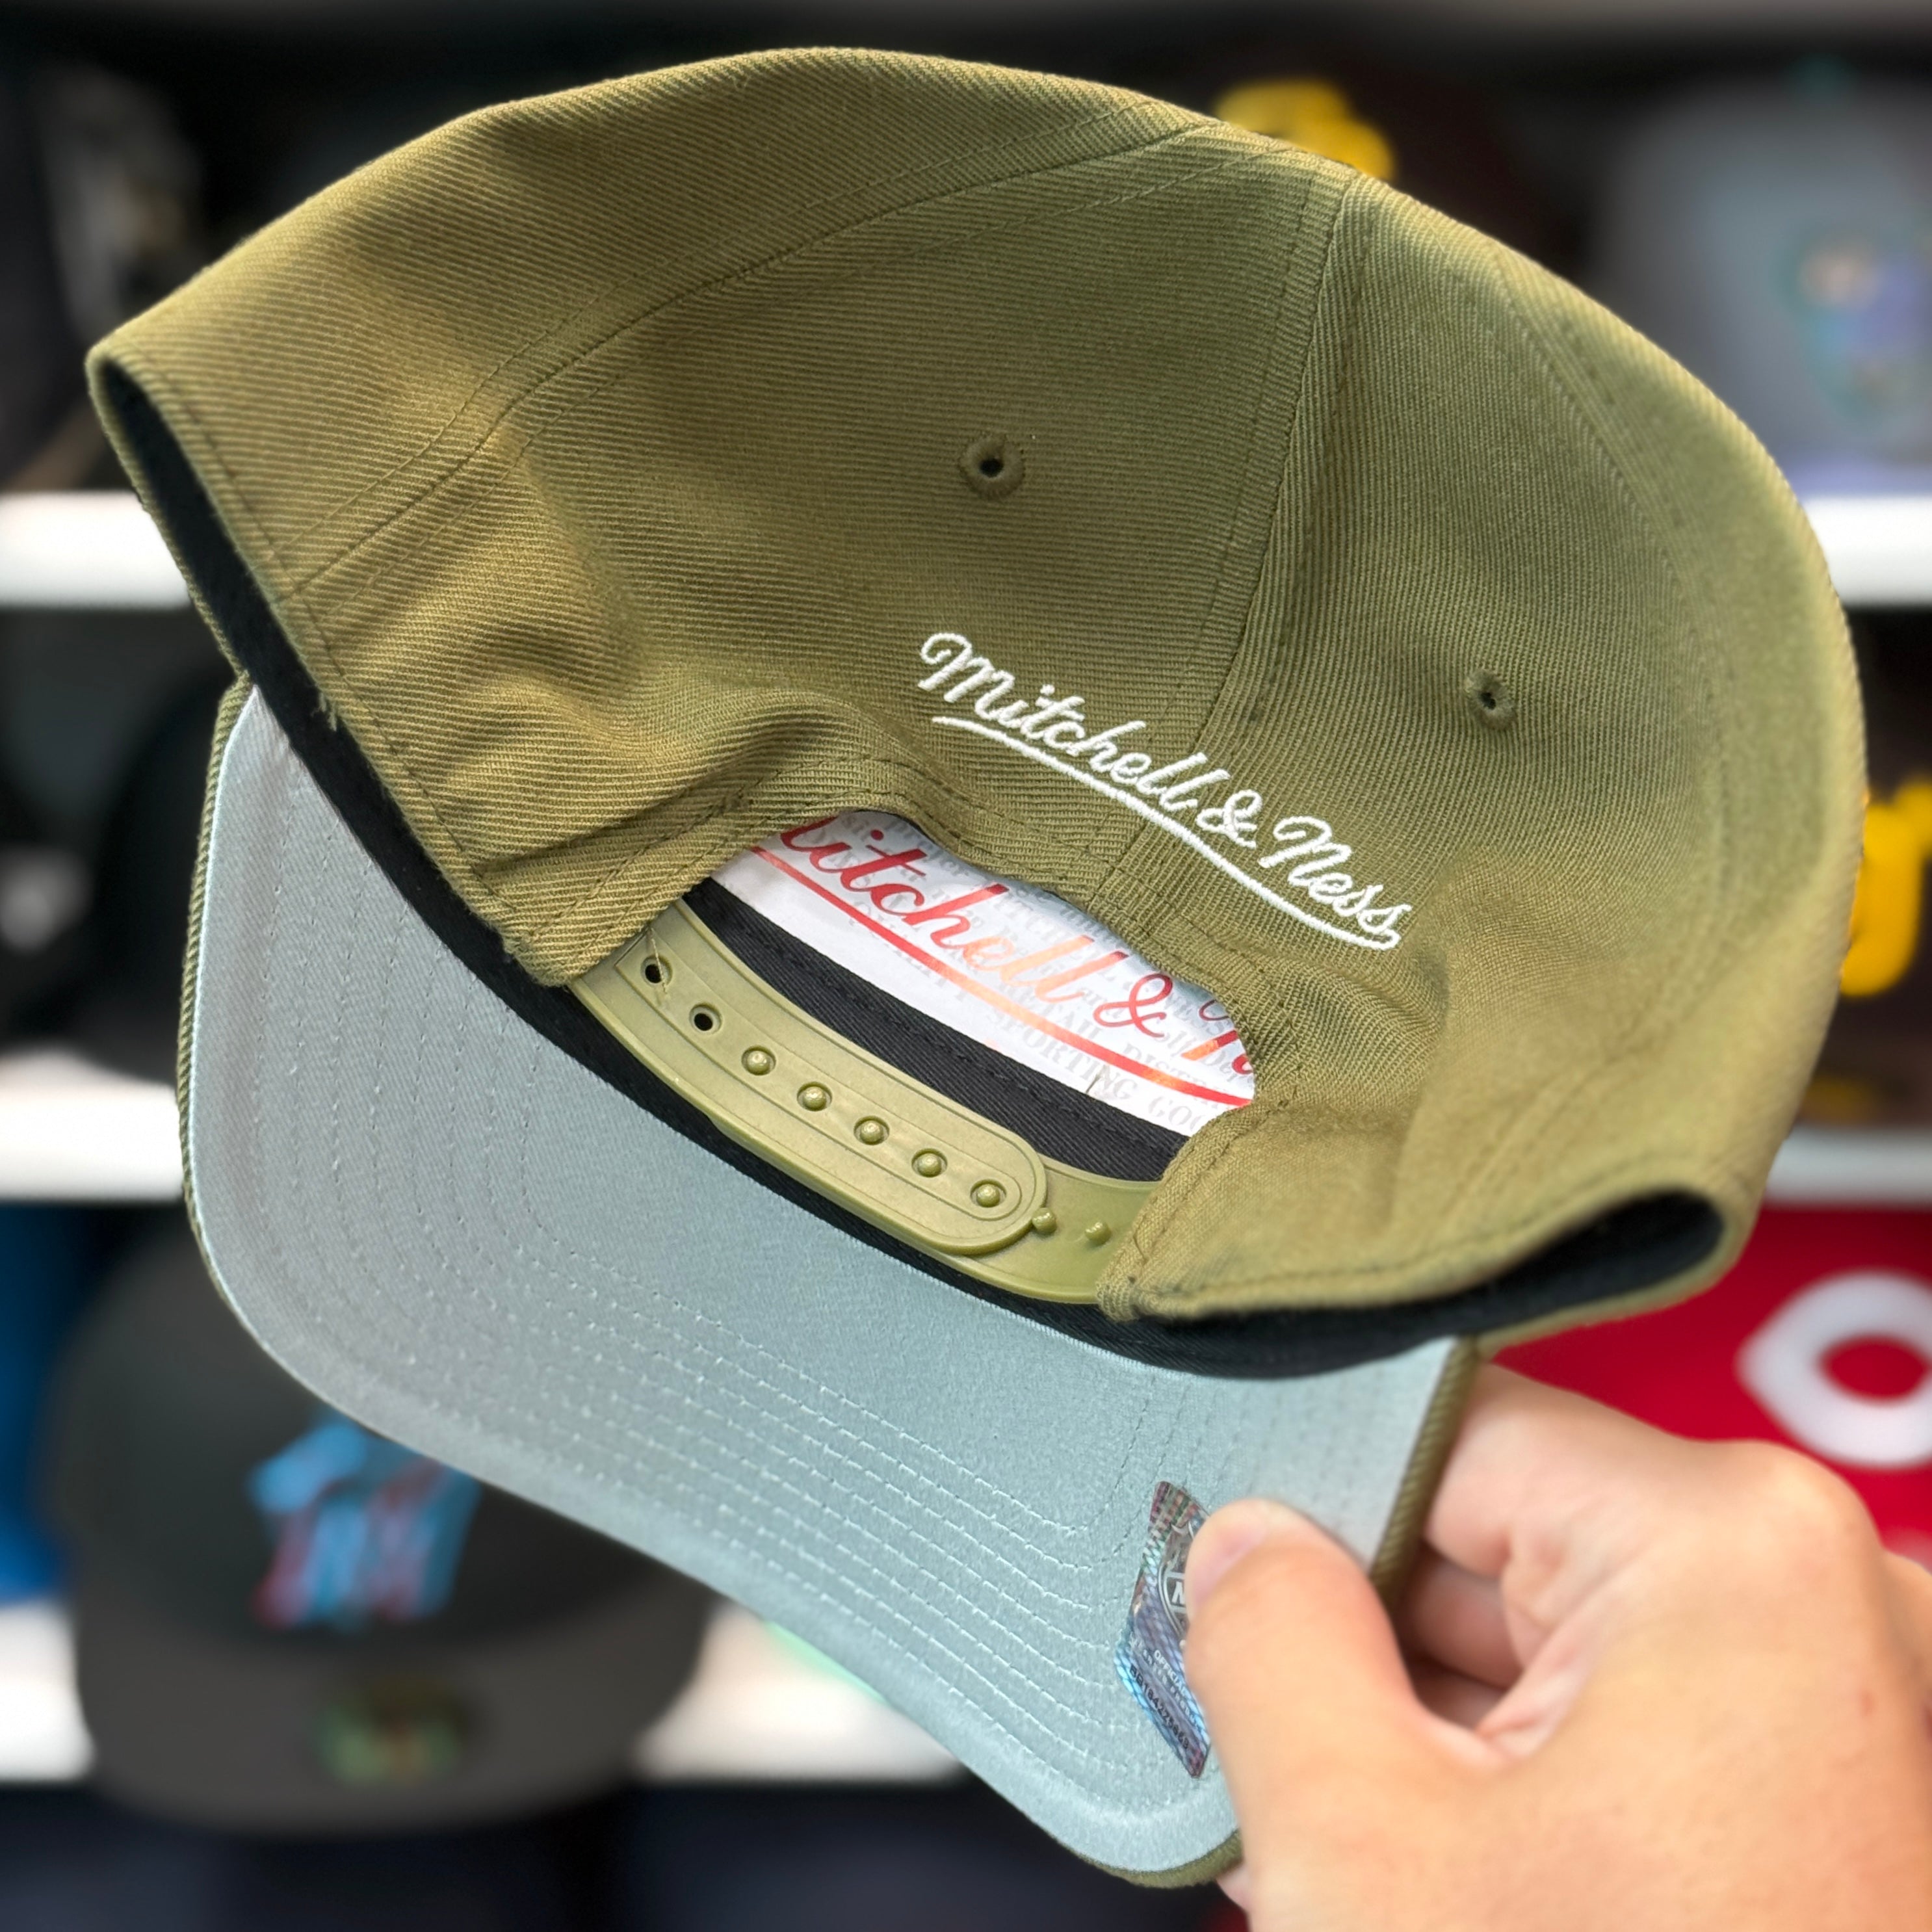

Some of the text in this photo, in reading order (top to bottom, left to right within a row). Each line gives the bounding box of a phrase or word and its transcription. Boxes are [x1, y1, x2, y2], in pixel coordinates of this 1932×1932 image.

[919, 633, 1413, 935] Mitchell & Ness
[1094, 974, 1173, 1037] &
